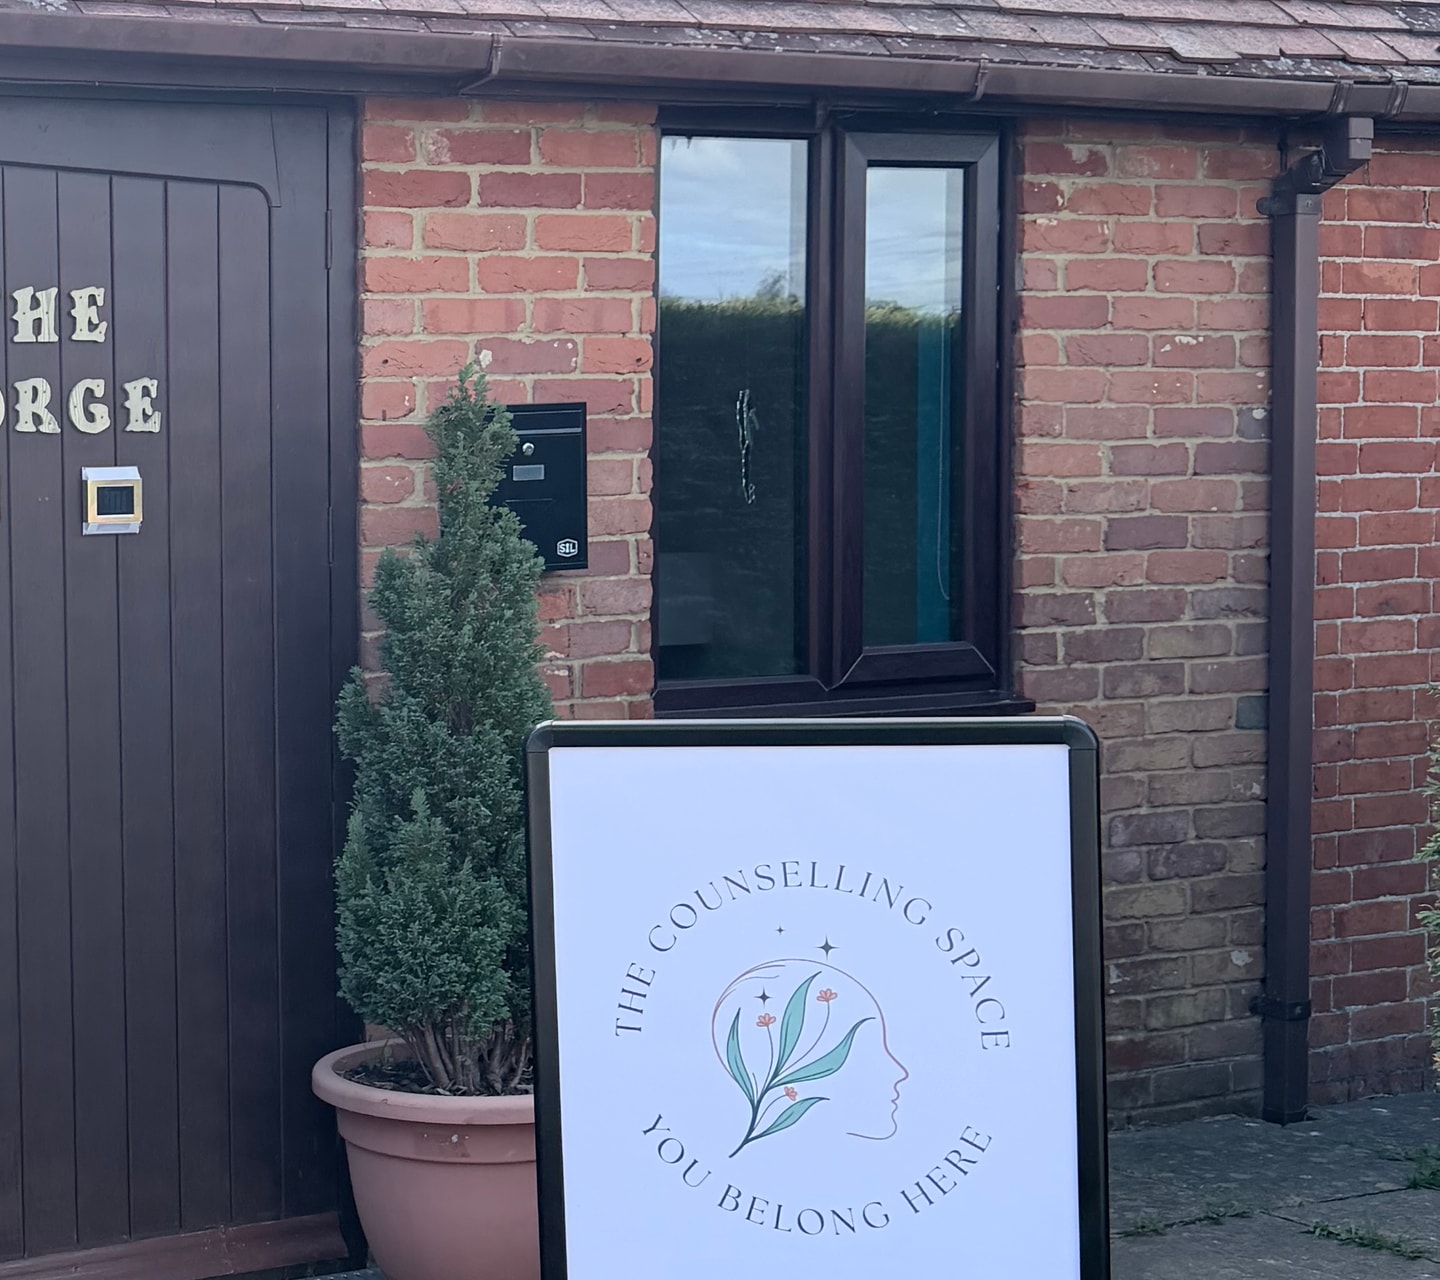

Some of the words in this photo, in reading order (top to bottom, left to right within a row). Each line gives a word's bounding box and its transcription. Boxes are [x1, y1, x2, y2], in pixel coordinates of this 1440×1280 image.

[559, 542, 575, 553] SIL
[615, 963, 657, 1037] THE
[649, 861, 932, 952] COUNSELLING
[936, 927, 1010, 1051] SPACE
[641, 1114, 712, 1188] YOU
[717, 1183, 890, 1236] BELONG
[899, 1125, 993, 1215] HERE
